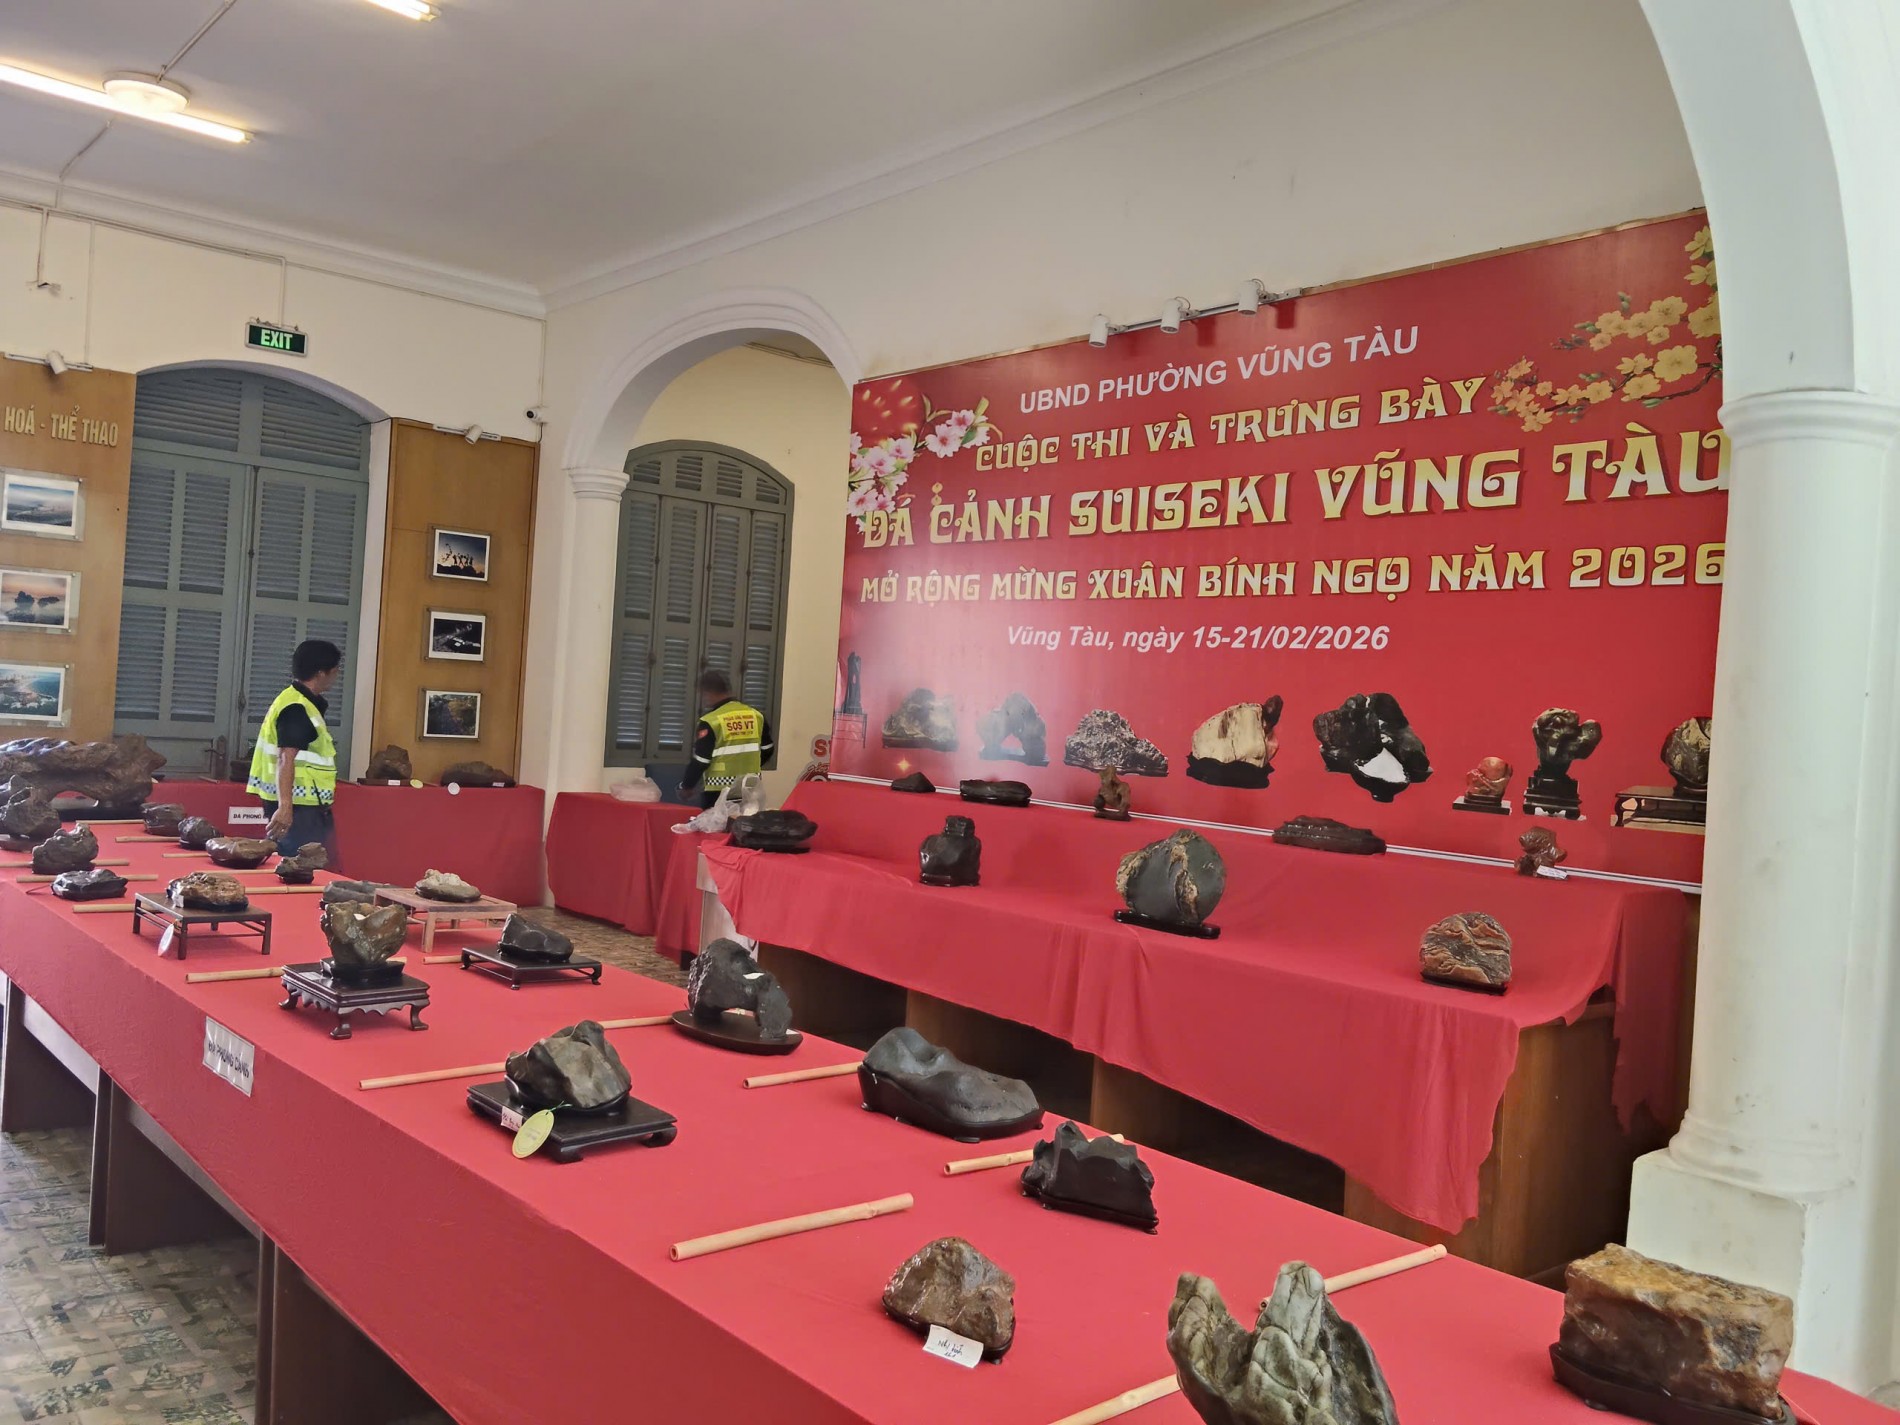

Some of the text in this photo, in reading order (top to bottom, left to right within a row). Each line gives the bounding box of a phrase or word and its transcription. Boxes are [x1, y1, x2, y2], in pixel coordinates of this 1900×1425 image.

[260, 328, 293, 350] EXIT
[1020, 326, 1419, 414] UBND PHƯỜNG VŨNG TÀU
[82, 418, 119, 448] THAO
[975, 375, 1487, 472] CUỘC THI VÀ TRƯNG BÀY
[929, 488, 1052, 545] CẢNH
[1068, 471, 1293, 537] SUISEKI
[1314, 448, 1526, 520] VŨNG
[1552, 422, 1731, 501] TÀU
[860, 542, 1725, 607] MỞ RỘNG MỪNG XUÂN BÍNH NGỌ NĂM 2026
[1007, 624, 1391, 654] Vũng Tàu, ngày 15-21/02/2026
[726, 720, 754, 731] SOS VT
